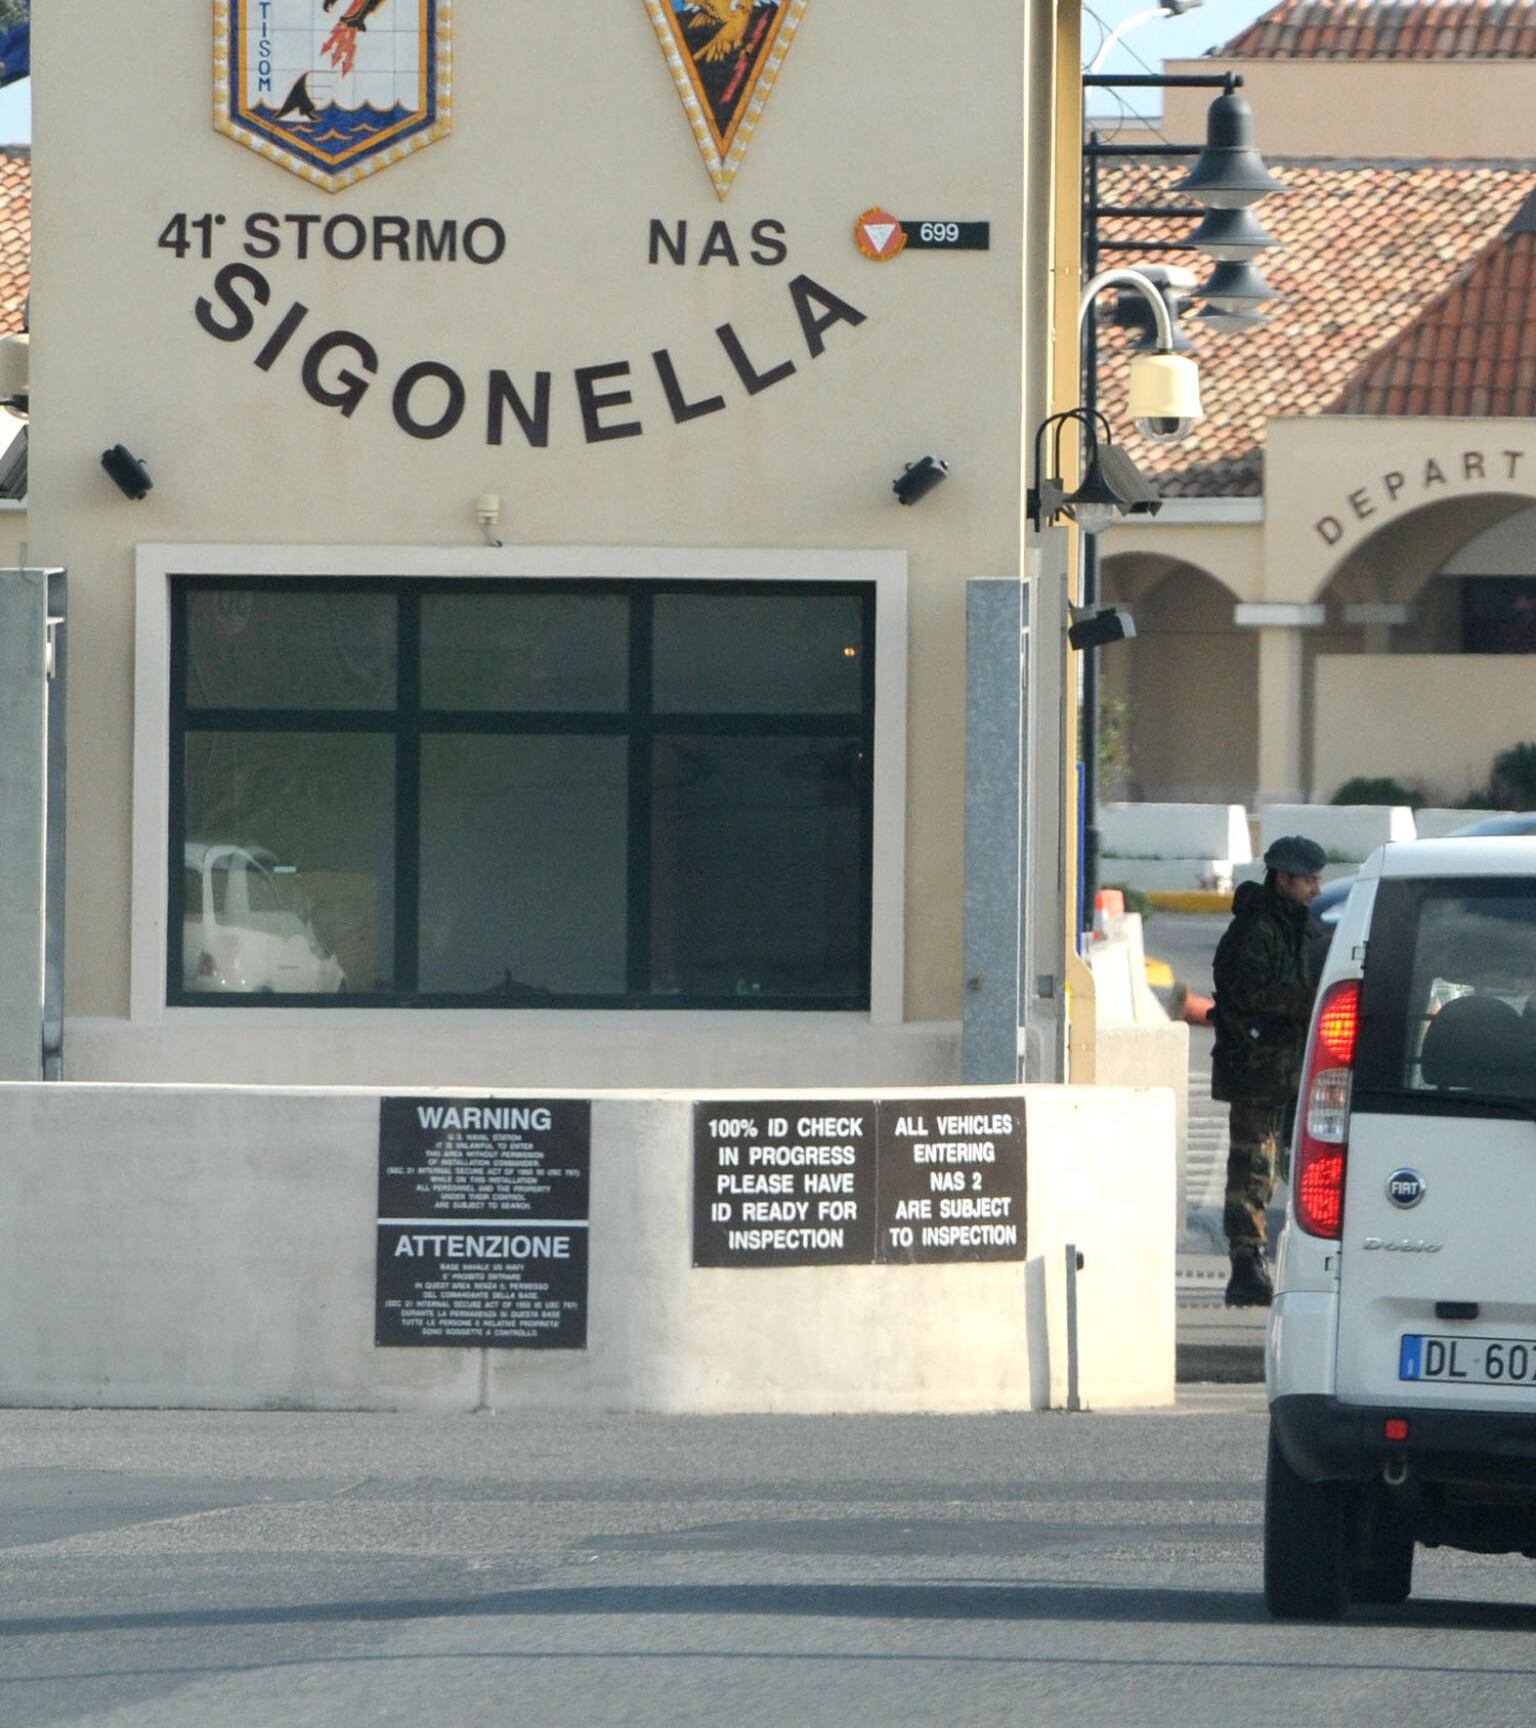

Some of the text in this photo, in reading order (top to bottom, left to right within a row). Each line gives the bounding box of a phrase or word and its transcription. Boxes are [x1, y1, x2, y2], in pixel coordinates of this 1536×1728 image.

[243, 211, 506, 265] STORMO
[648, 219, 787, 267] NAS
[920, 222, 959, 242] 699
[196, 262, 866, 448] SIGONELLA
[416, 1106, 552, 1131] WARNING
[708, 1117, 863, 1138] 100% ID CHECK
[894, 1113, 1013, 1137] ALL VEHICLES
[718, 1145, 856, 1167] IN PROGRESS
[913, 1141, 996, 1164] ENTERING
[717, 1173, 855, 1195] PLEASE HAVE
[929, 1171, 983, 1192] NAS 2
[1391, 1181, 1420, 1196] FIAT
[711, 1201, 858, 1222] ID READY FOR
[894, 1196, 1012, 1220] ARE SUBJECT
[394, 1234, 571, 1259] ATTENZIONE
[728, 1228, 844, 1250] INSPECTION
[888, 1224, 1017, 1248] TO INSPECTION
[1425, 1340, 1467, 1378] DL
